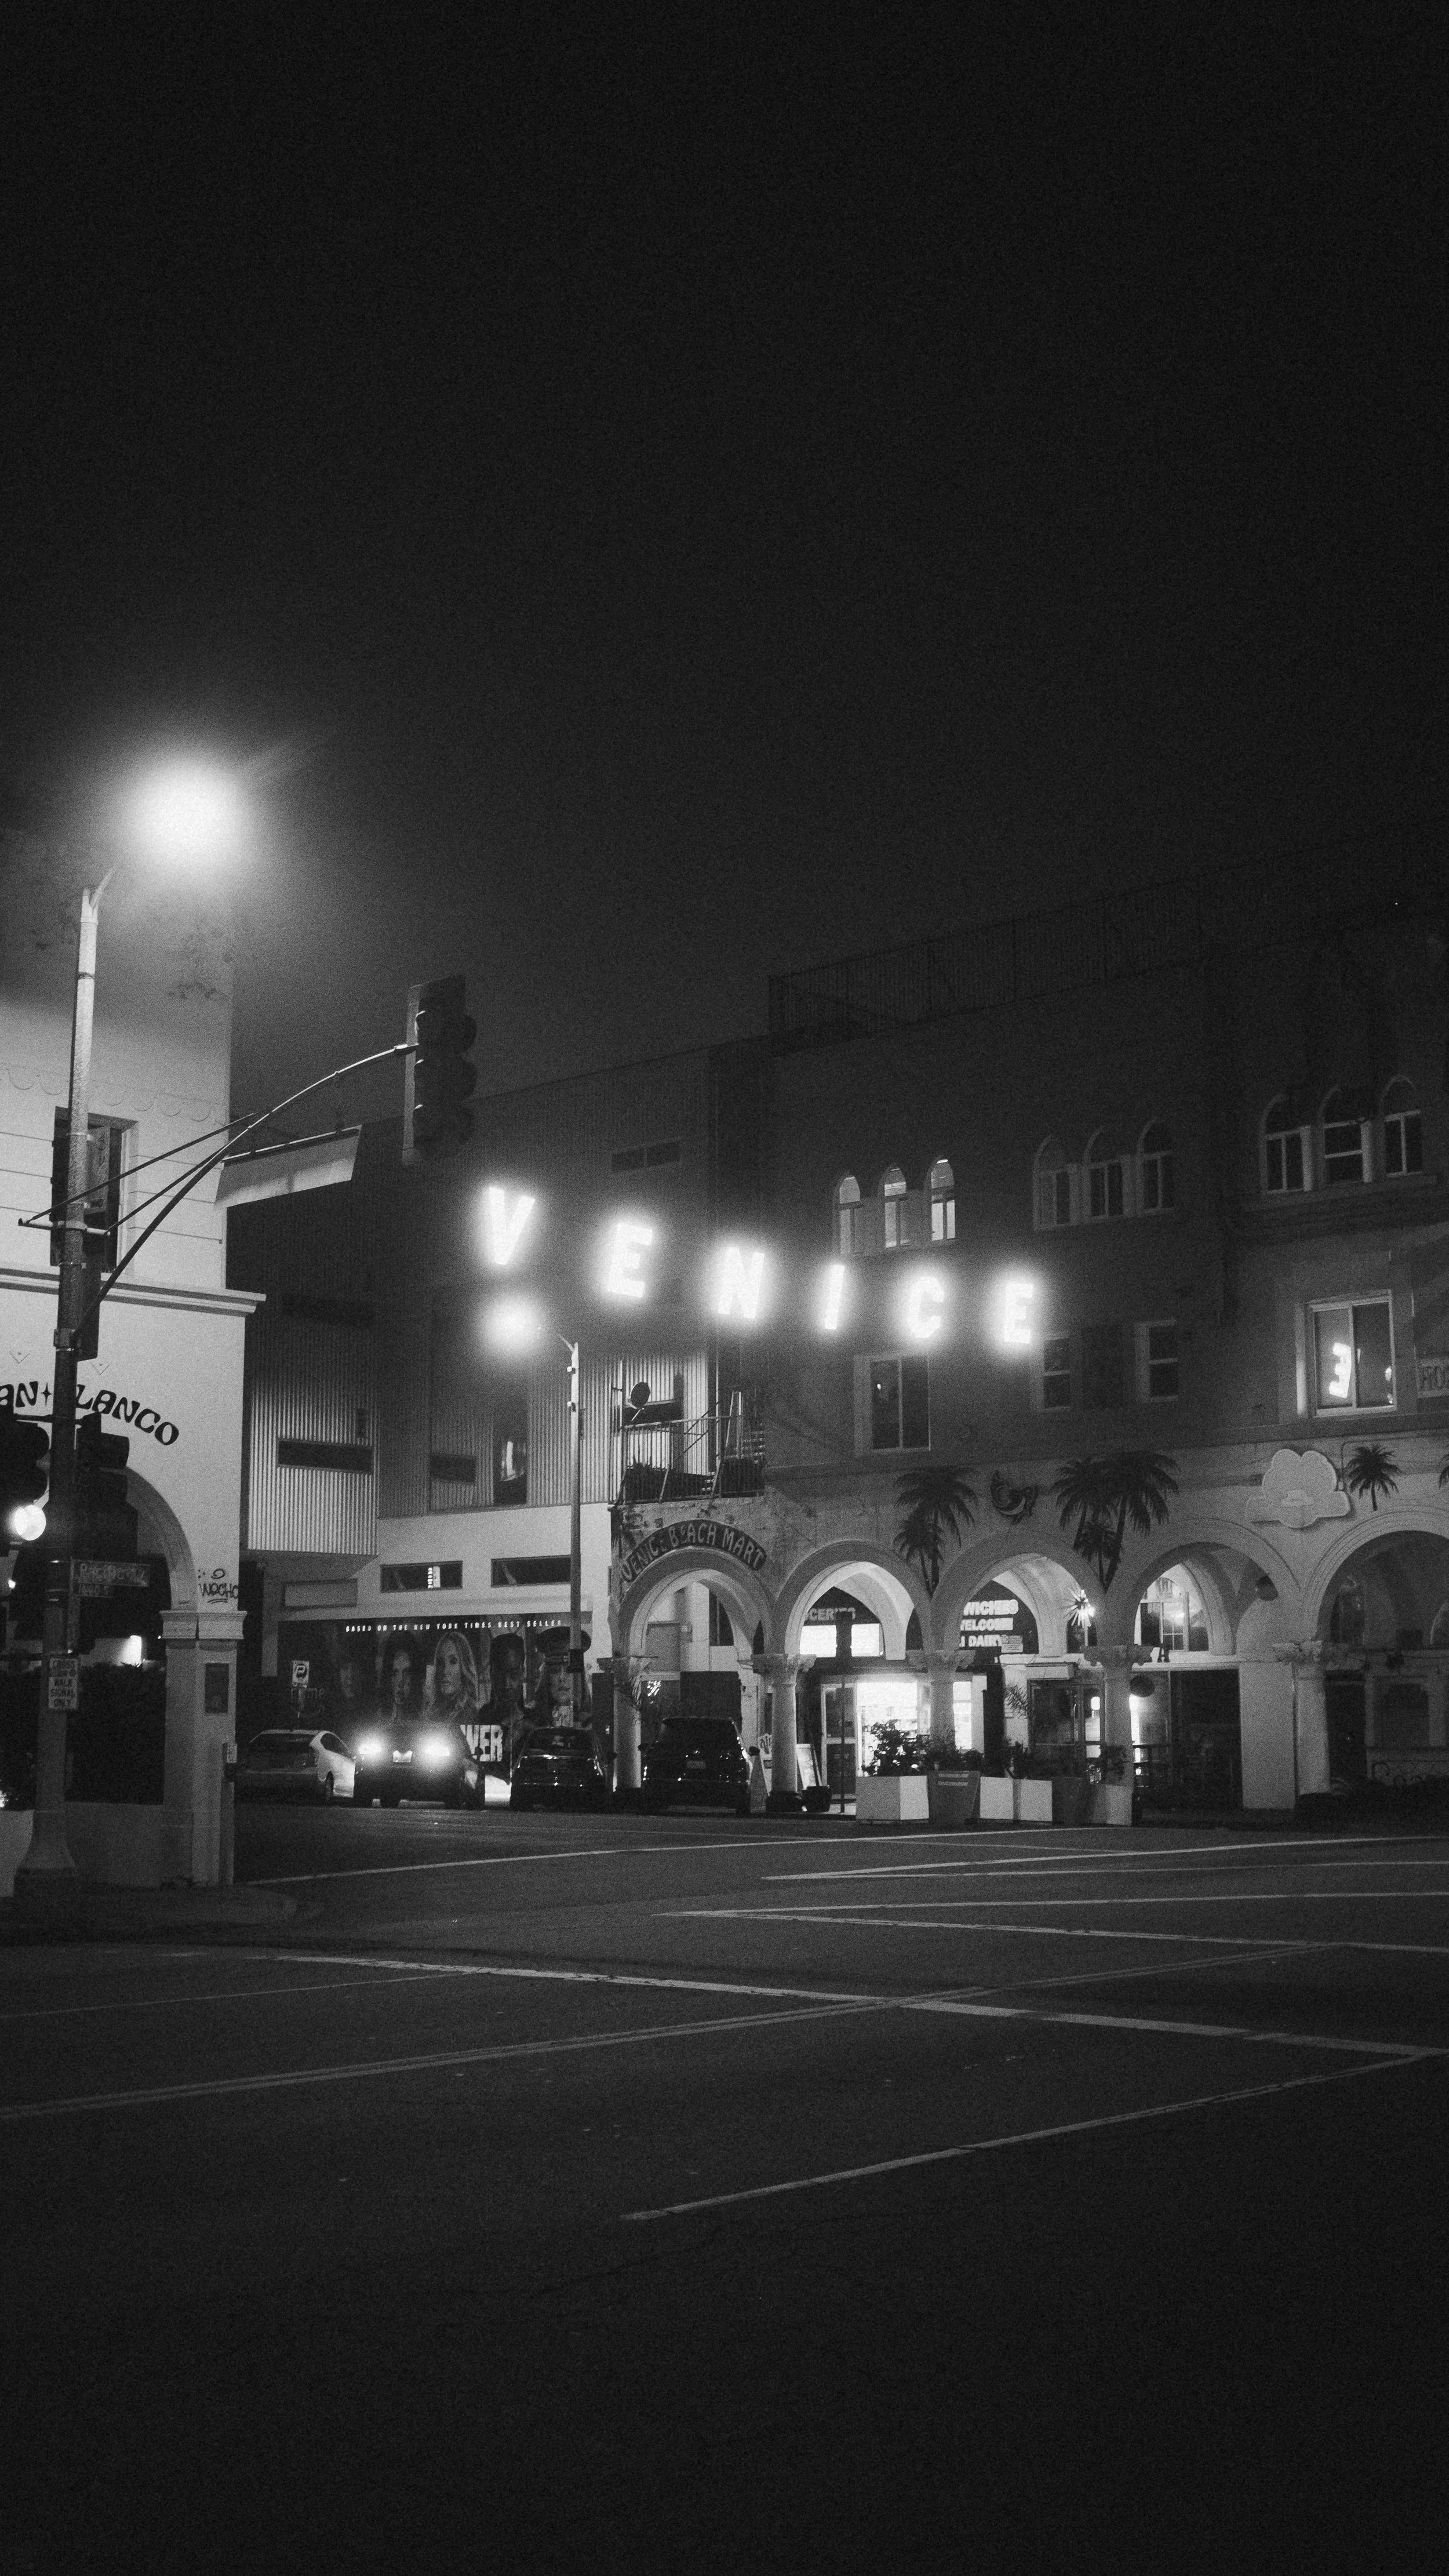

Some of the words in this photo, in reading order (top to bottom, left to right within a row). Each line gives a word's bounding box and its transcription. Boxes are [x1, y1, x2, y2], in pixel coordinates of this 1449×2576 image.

[483, 1184, 1036, 1345] VENICE
[76, 1383, 180, 1445] LANCO
[621, 1536, 668, 1582] VENICE
[668, 1522, 717, 1549] BEACH
[721, 1527, 766, 1568] MART
[345, 1625, 372, 1633] BASED
[526, 1619, 561, 1627] SELLER
[54, 1678, 72, 1687] WALK
[50, 1688, 75, 1698] SIGNAL
[53, 1698, 71, 1707] ONLY
